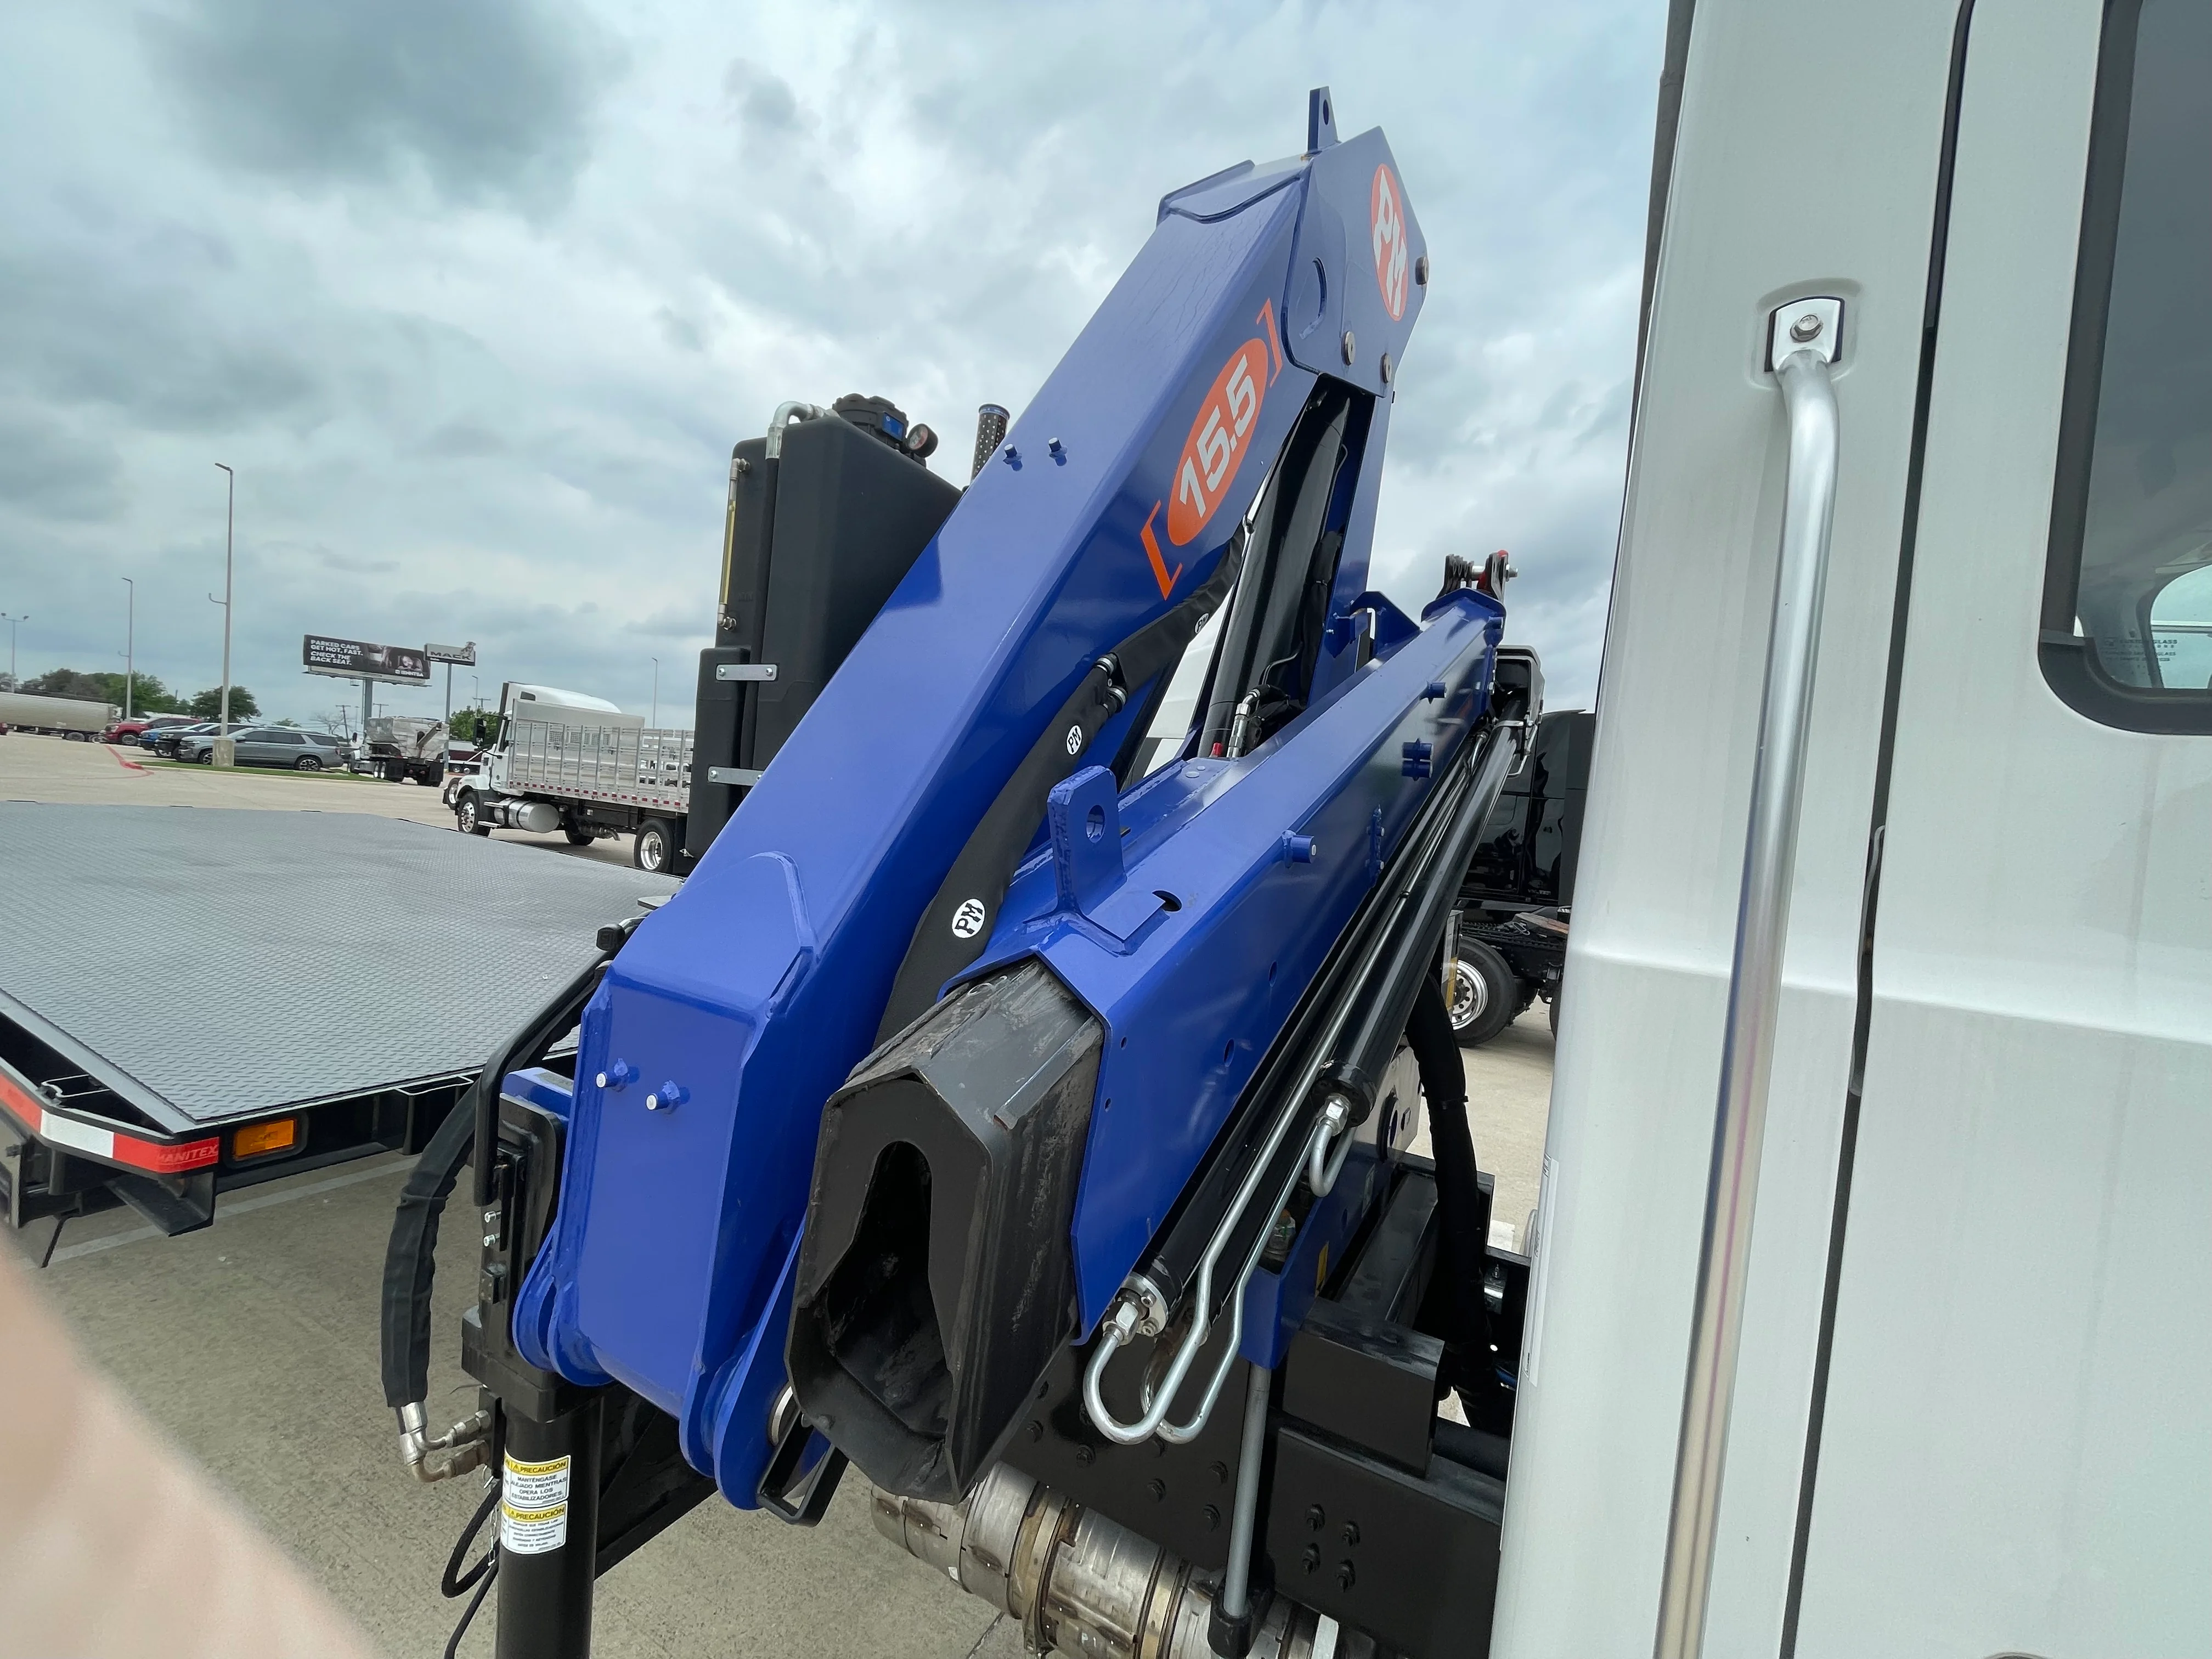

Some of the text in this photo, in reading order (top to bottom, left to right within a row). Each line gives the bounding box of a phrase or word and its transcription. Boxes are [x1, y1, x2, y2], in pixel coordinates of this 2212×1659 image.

[1180, 353, 1256, 519] 15.5
[311, 639, 340, 648] PARKED
[430, 651, 471, 661] MACK
[1068, 727, 1081, 753] PM
[955, 902, 983, 934] PM
[157, 1144, 219, 1163] MANITEX
[521, 1462, 566, 1473] PRECAUCIÓN
[517, 1474, 557, 1482] MANTÉNGASE
[535, 1477, 567, 1488] MIENTRAS
[516, 1507, 565, 1520] PRECAUCIÓN
